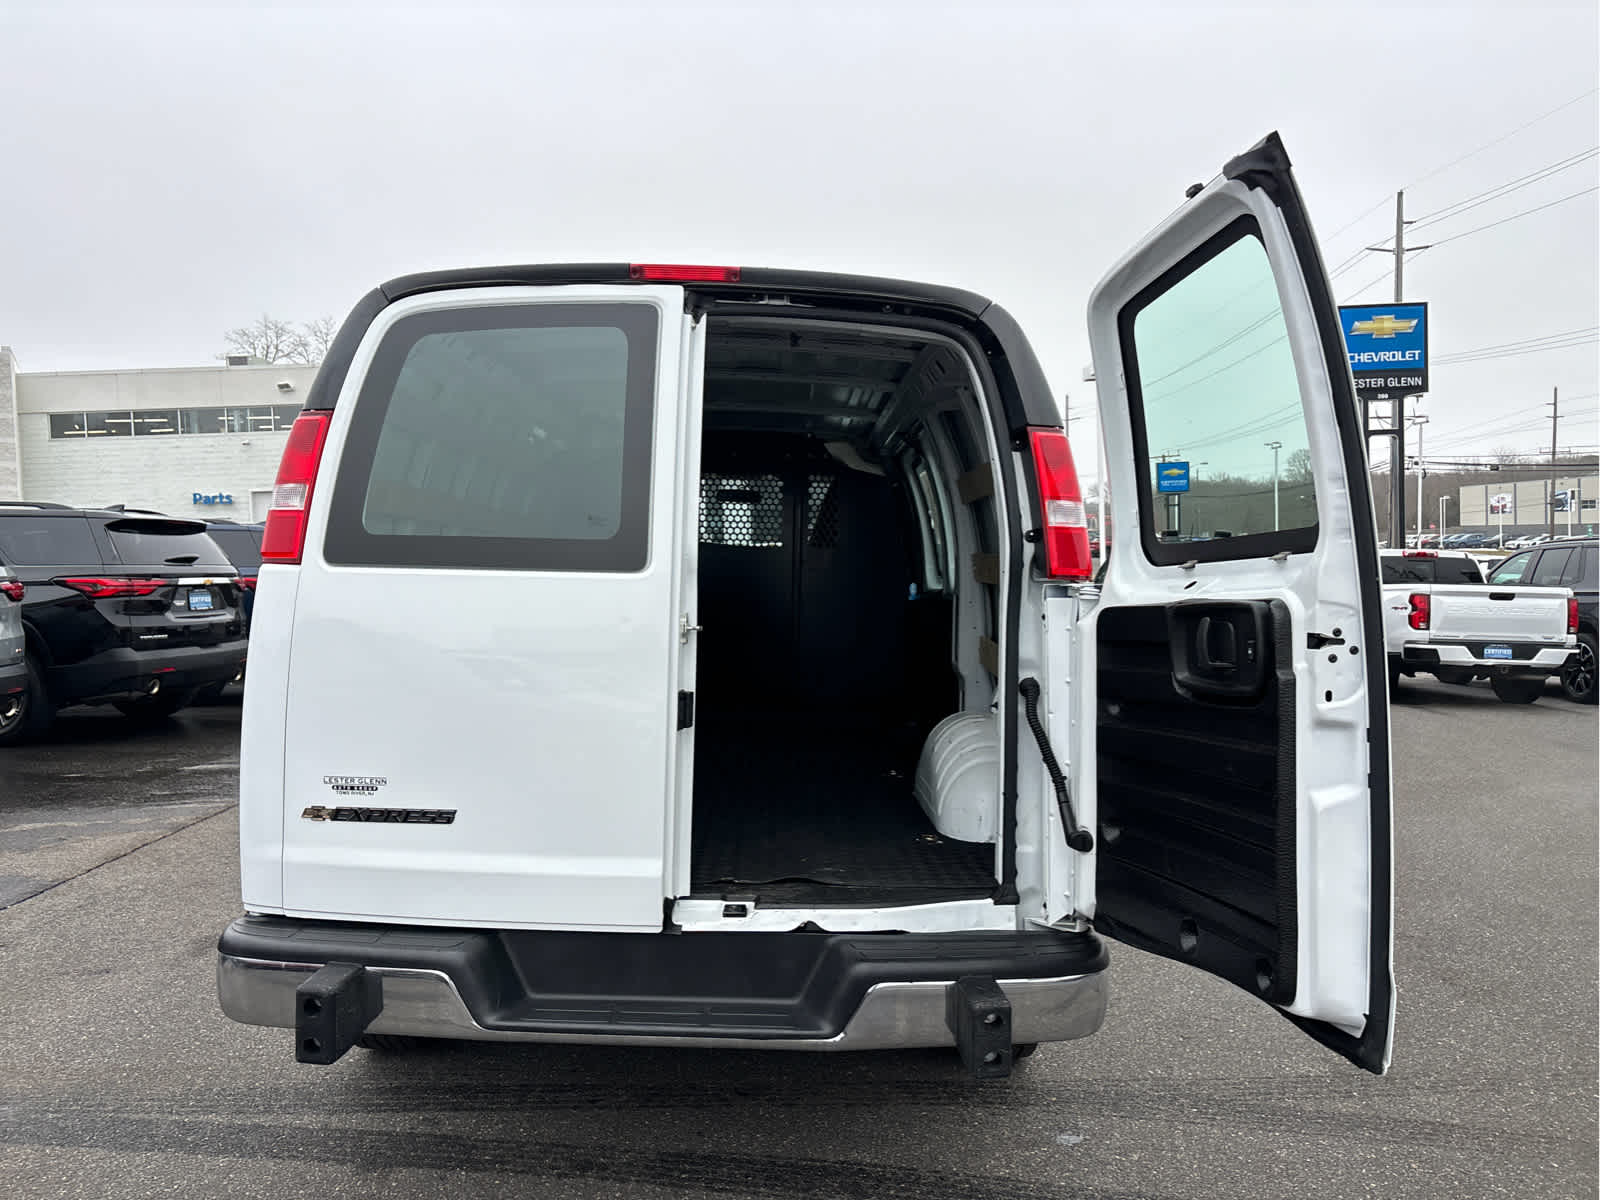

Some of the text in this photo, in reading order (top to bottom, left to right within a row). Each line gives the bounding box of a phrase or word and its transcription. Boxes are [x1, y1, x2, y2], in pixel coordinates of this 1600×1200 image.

[1347, 350, 1421, 363] CHEVROLET
[1352, 376, 1422, 389] ESTER GLENN
[193, 492, 233, 505] Parts
[323, 775, 387, 786] LESTER GLENN
[330, 806, 458, 825] EXPRESS
